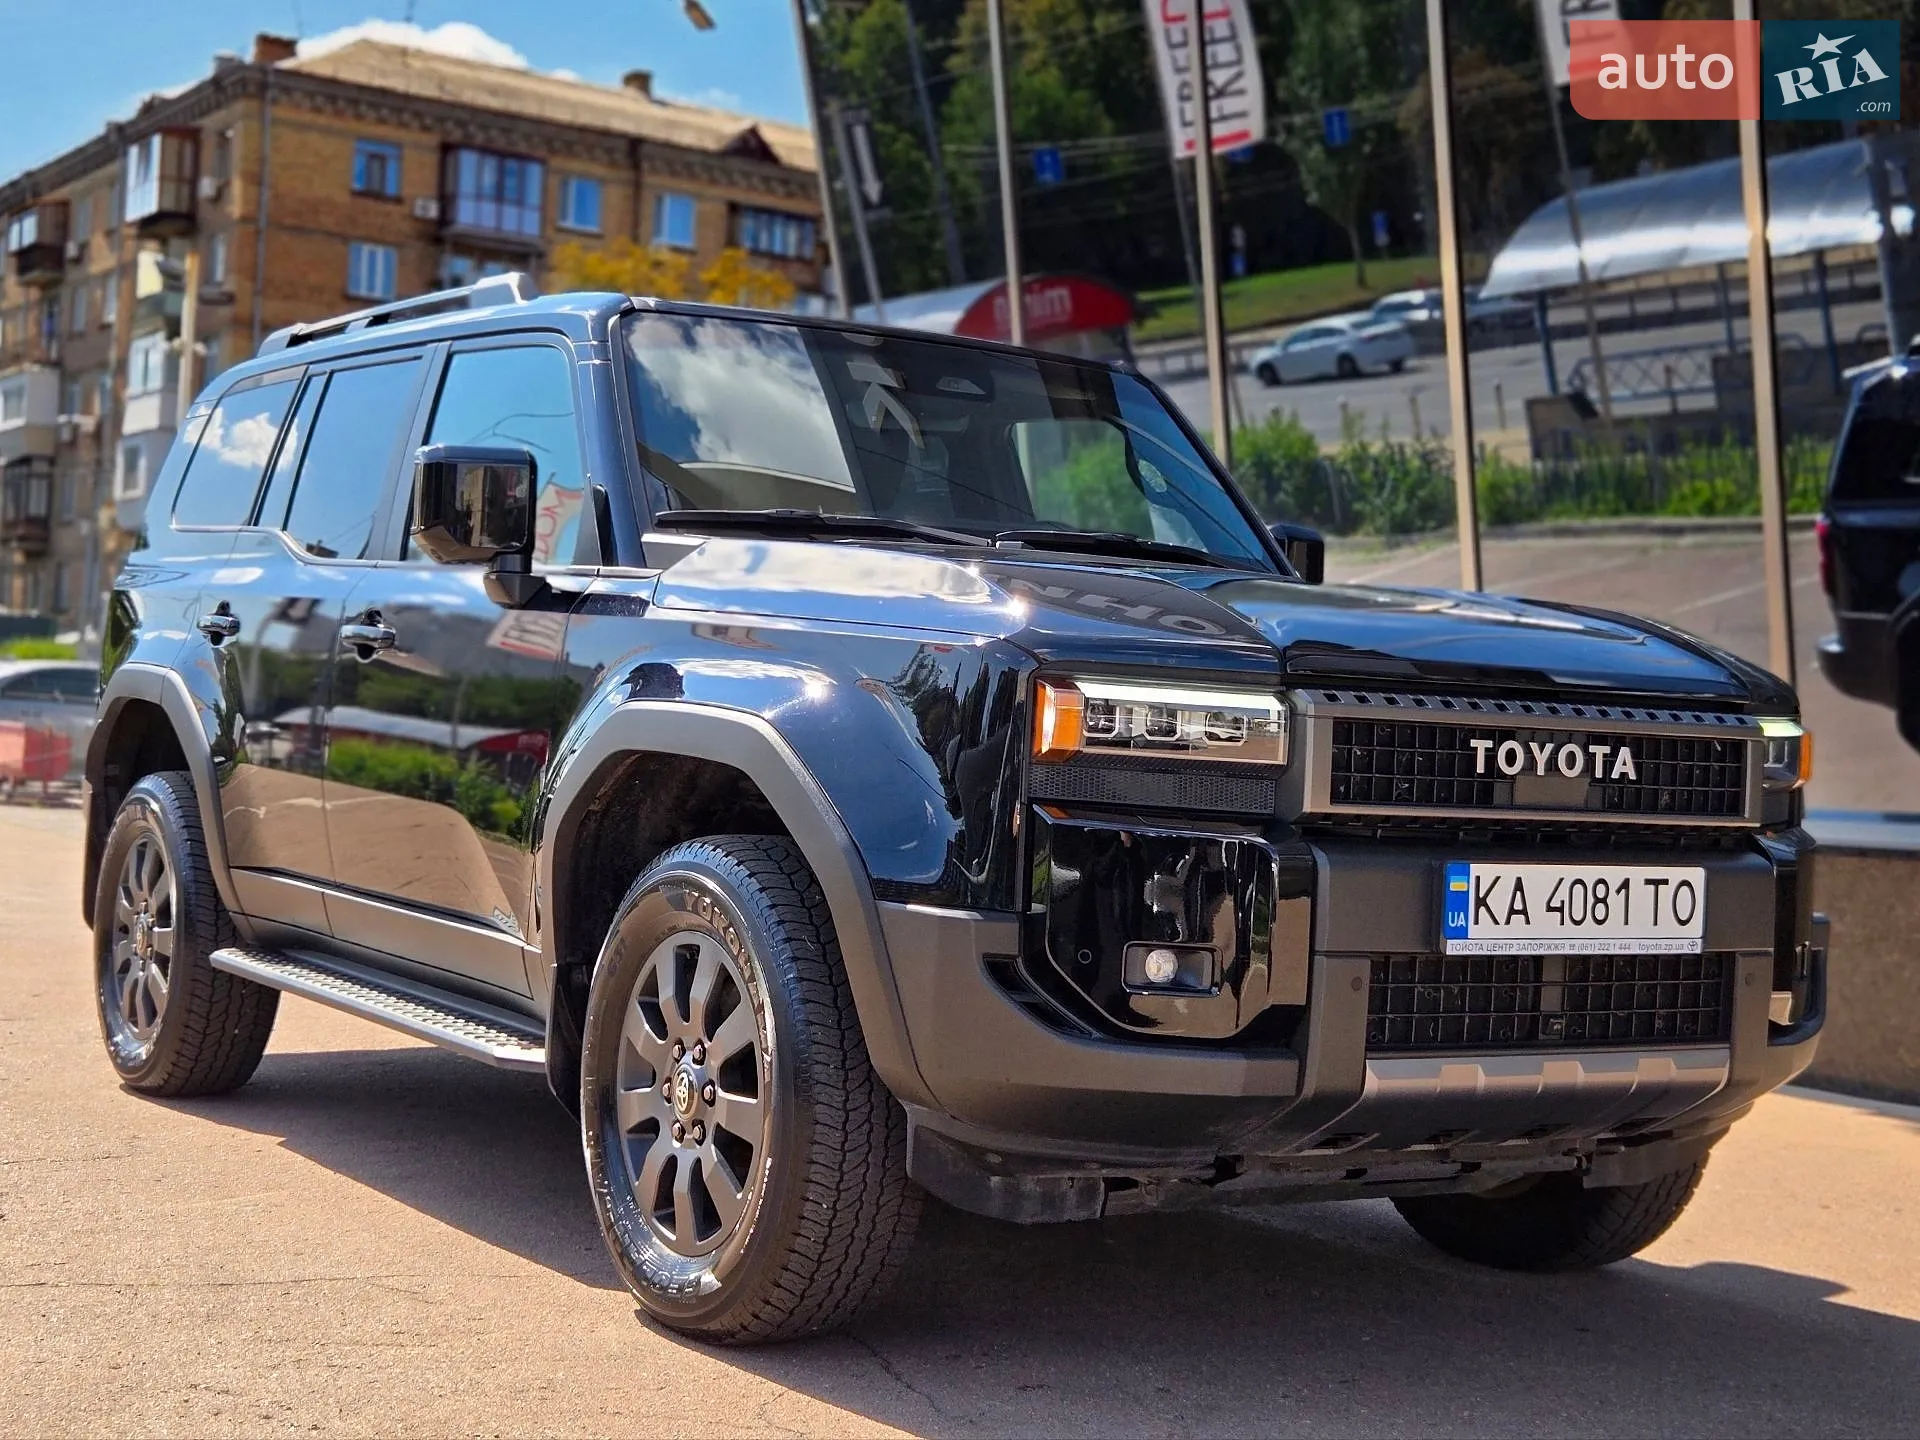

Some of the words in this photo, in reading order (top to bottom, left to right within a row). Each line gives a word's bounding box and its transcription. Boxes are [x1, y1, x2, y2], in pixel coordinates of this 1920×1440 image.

[1470, 738, 1637, 780] TOYOTA
[1448, 911, 1467, 928] UA
[1472, 875, 1531, 926] KA
[1545, 877, 1630, 927] 4081
[1644, 878, 1697, 927] TO
